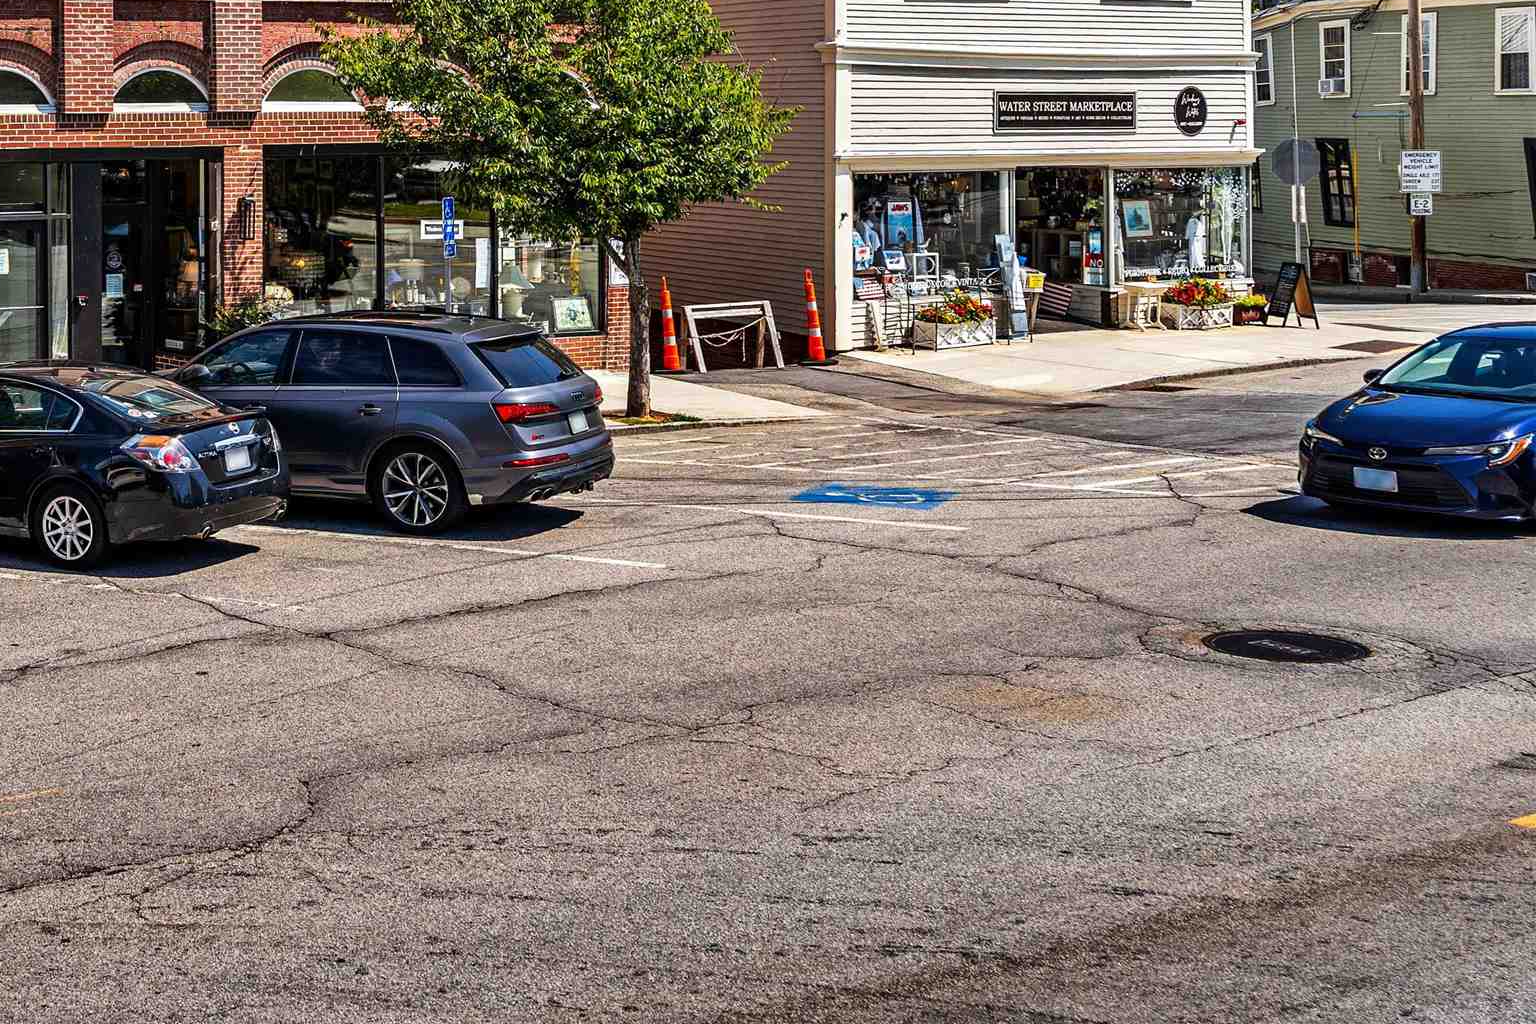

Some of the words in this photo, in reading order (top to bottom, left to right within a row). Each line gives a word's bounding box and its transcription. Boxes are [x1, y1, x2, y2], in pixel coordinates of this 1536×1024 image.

[999, 101, 1031, 112] WATER
[1032, 101, 1068, 112] STREET
[1069, 101, 1133, 112] MARKETPLACE
[1414, 199, 1429, 208] E-2
